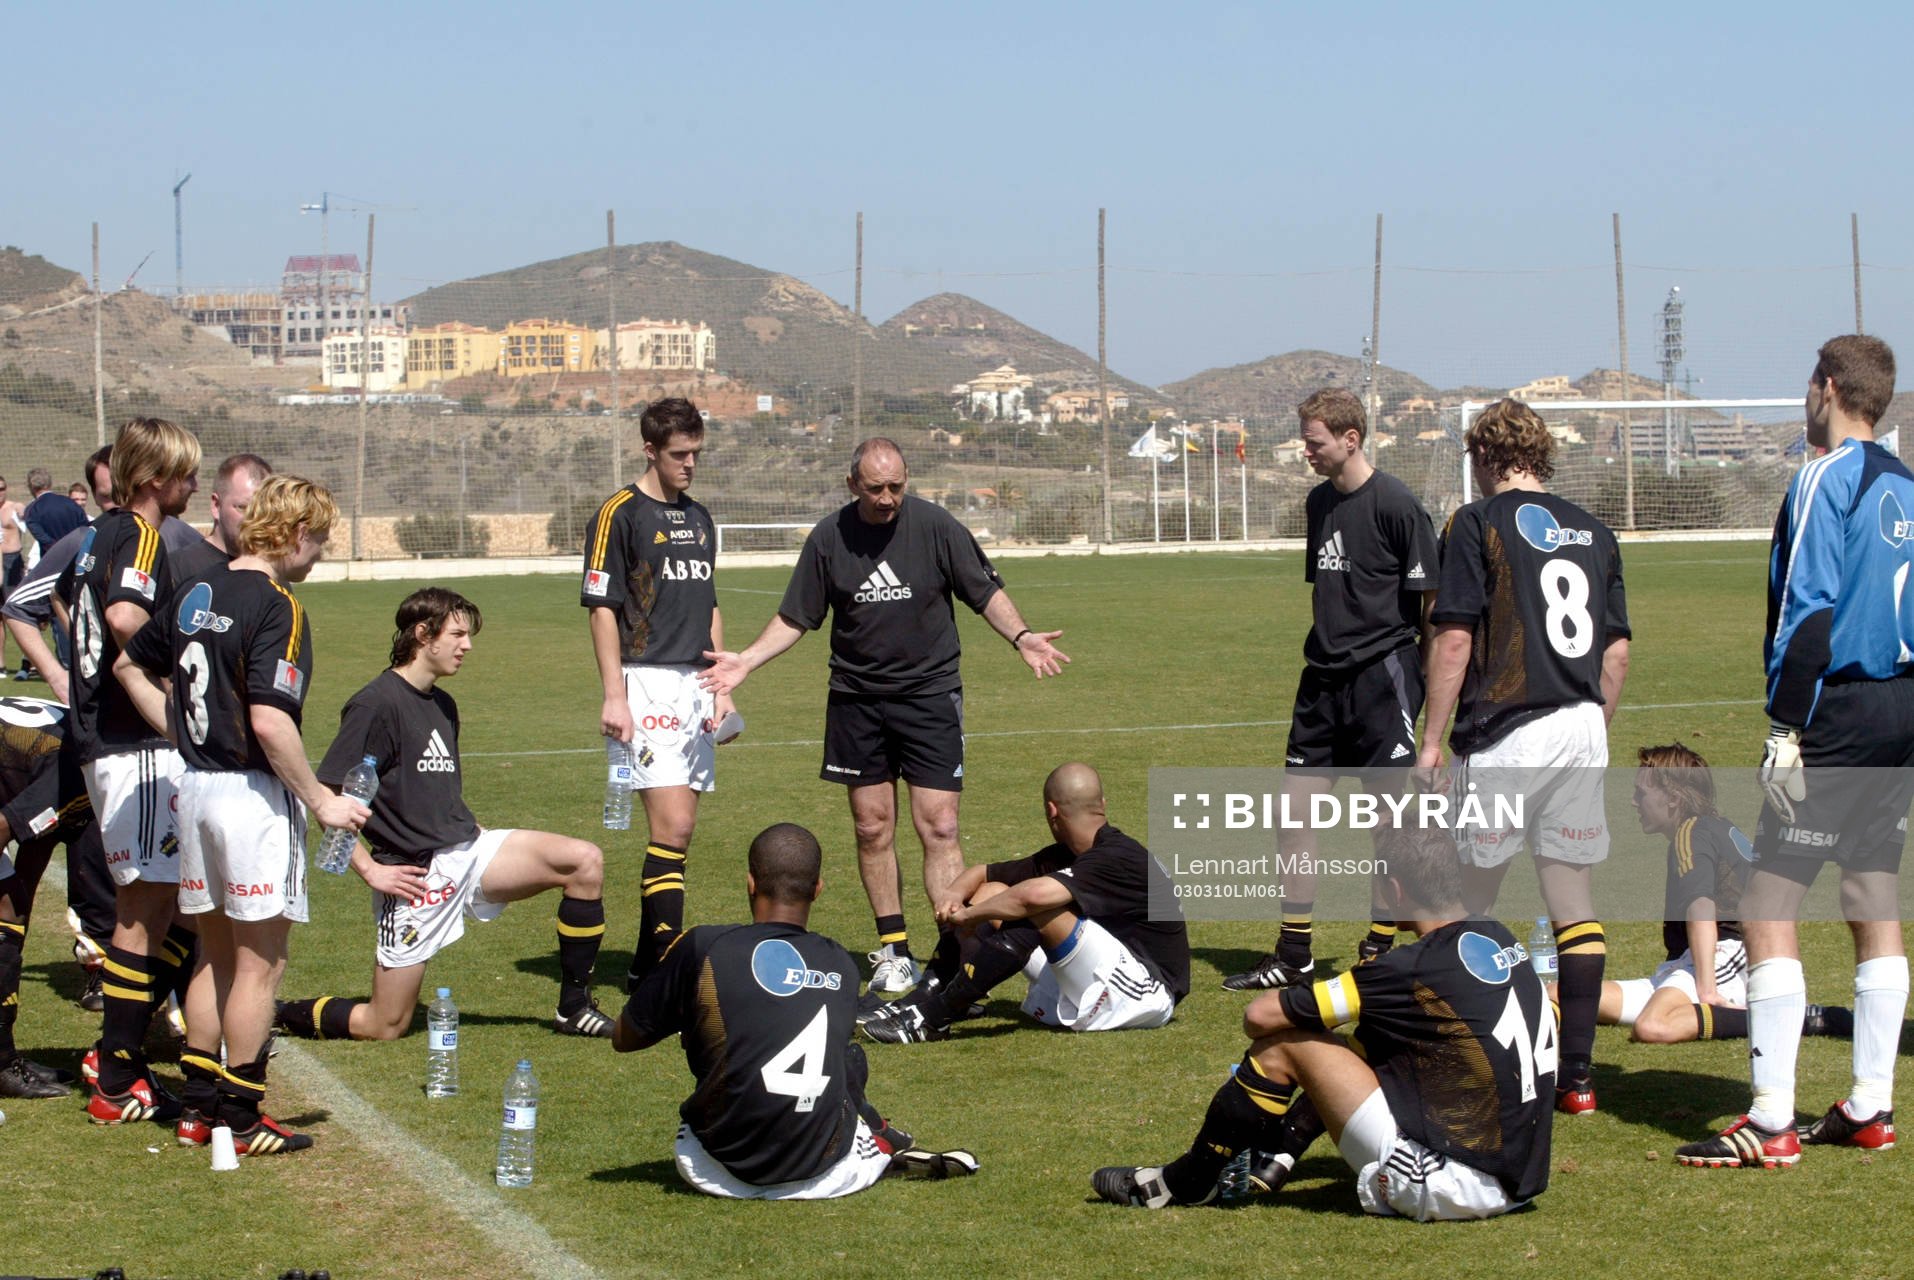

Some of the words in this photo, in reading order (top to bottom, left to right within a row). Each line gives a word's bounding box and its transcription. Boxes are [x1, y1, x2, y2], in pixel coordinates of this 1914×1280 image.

[1544, 528, 1592, 545] EDS
[190, 609, 233, 633] EDS
[854, 586, 912, 603] adidas
[1540, 559, 1593, 658] 8
[179, 641, 210, 745] 3
[783, 968, 842, 991] EDS
[761, 1004, 831, 1113] 4
[1492, 978, 1559, 1103] 14
